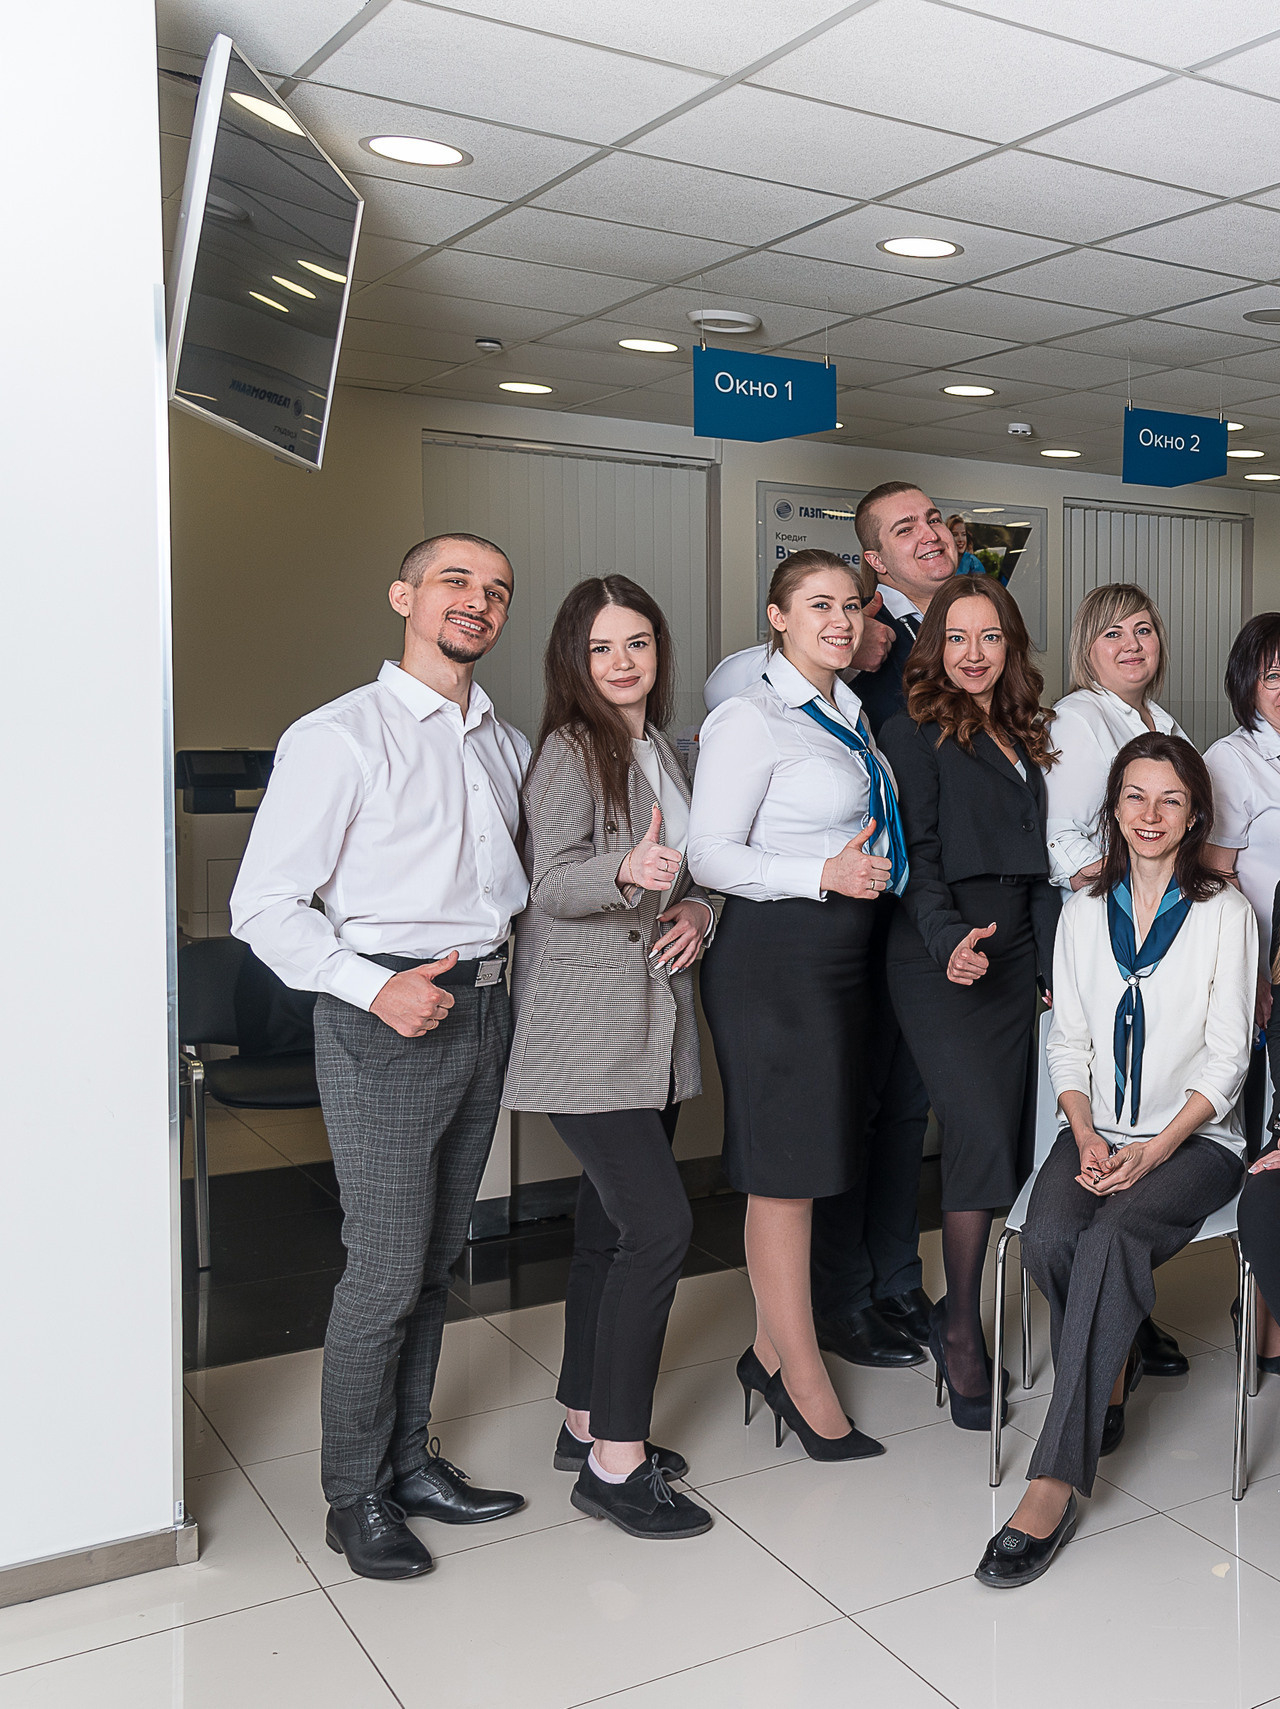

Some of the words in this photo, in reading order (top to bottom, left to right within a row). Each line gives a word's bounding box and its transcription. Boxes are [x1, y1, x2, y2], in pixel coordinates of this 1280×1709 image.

[714, 371, 778, 399] Окно
[784, 380, 792, 401] 1
[1139, 428, 1185, 451] Окно
[1190, 434, 1200, 453] 2
[775, 532, 807, 542] Кредит
